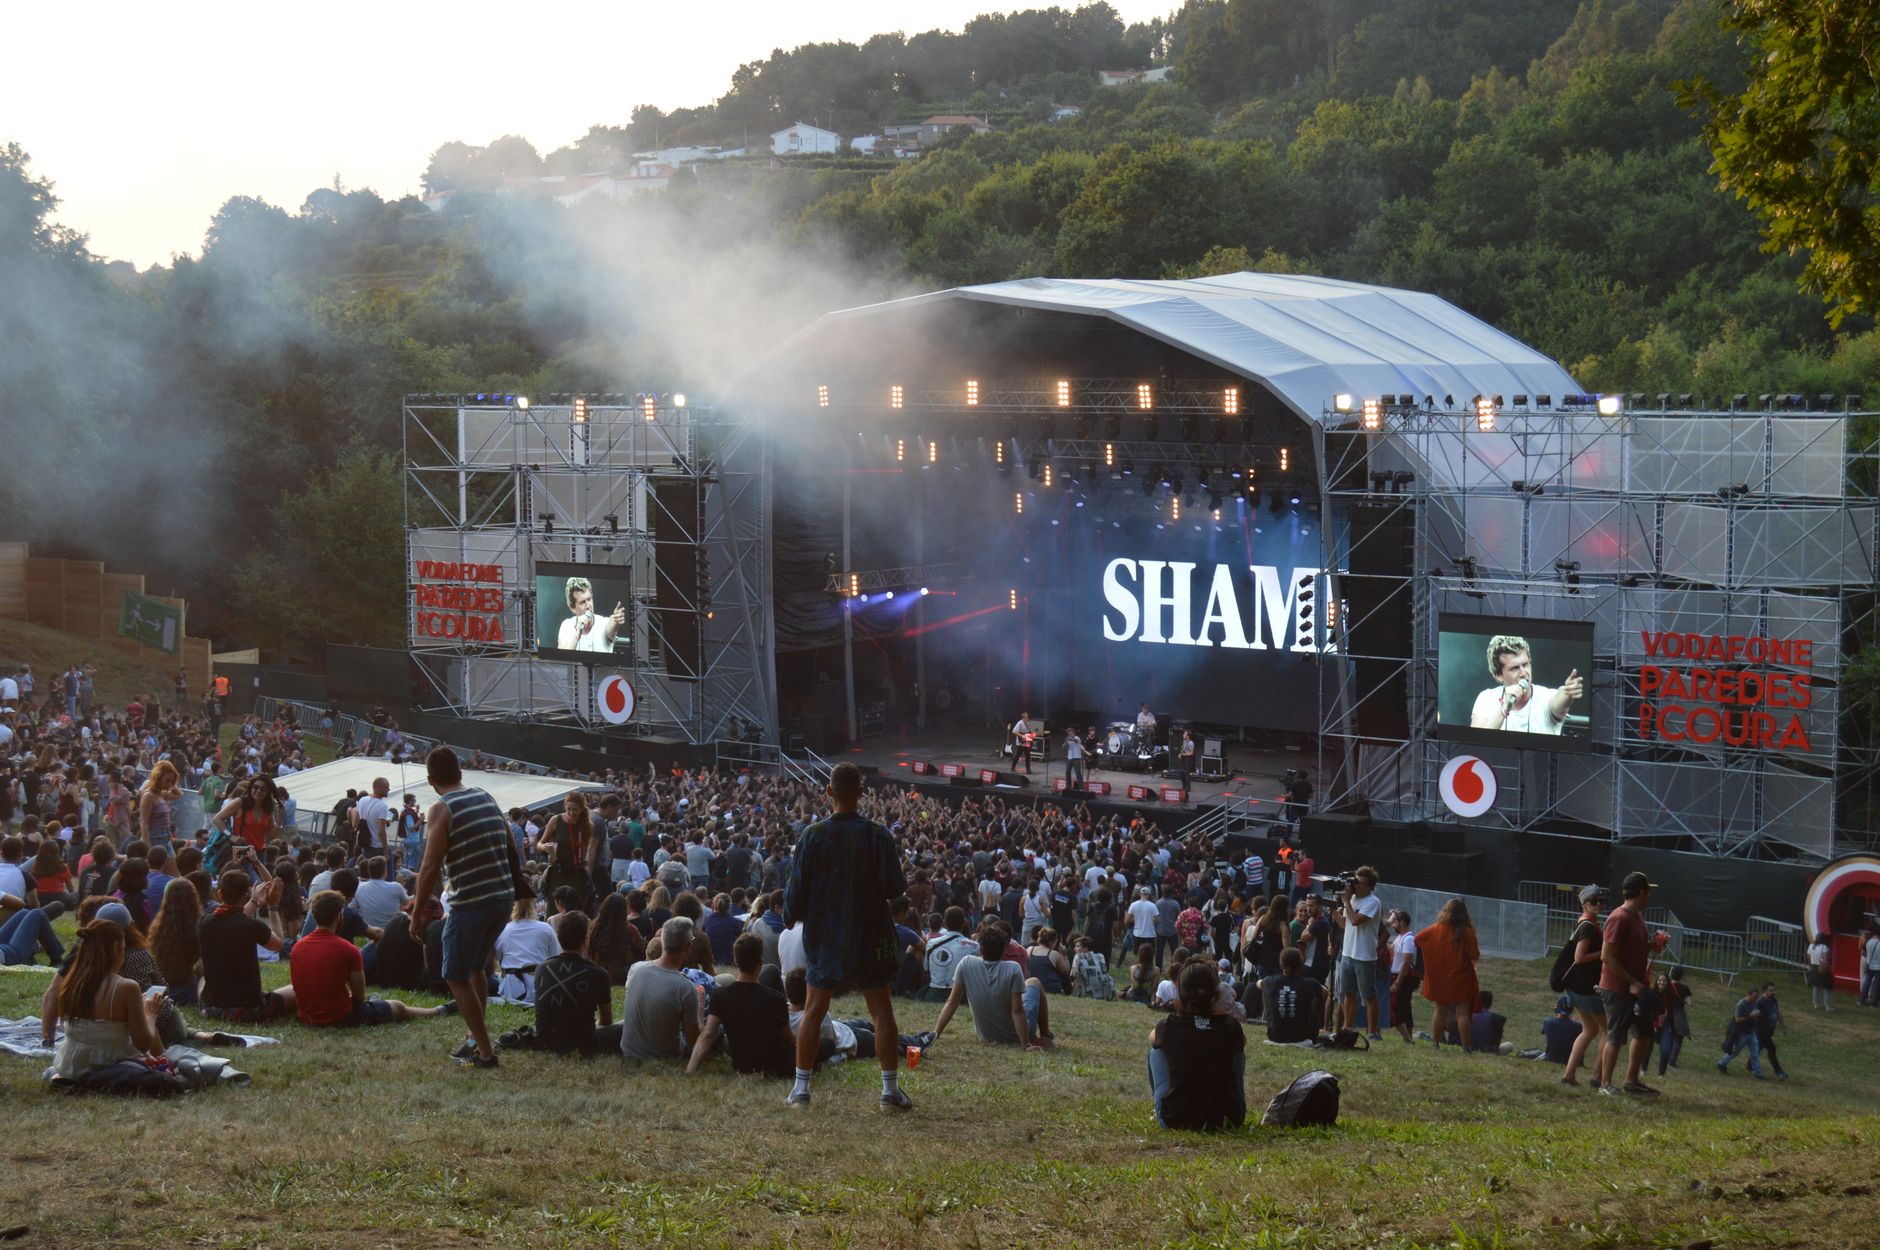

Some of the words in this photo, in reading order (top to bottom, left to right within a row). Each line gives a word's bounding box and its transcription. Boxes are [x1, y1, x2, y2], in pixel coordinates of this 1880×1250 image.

[416, 559, 503, 583] VODAFONE
[416, 584, 504, 613] PAREDES
[426, 612, 505, 642] COURA
[1641, 630, 1813, 667] VODAFONE
[1640, 665, 1812, 709] PAREDES
[1656, 705, 1812, 752] COURA
